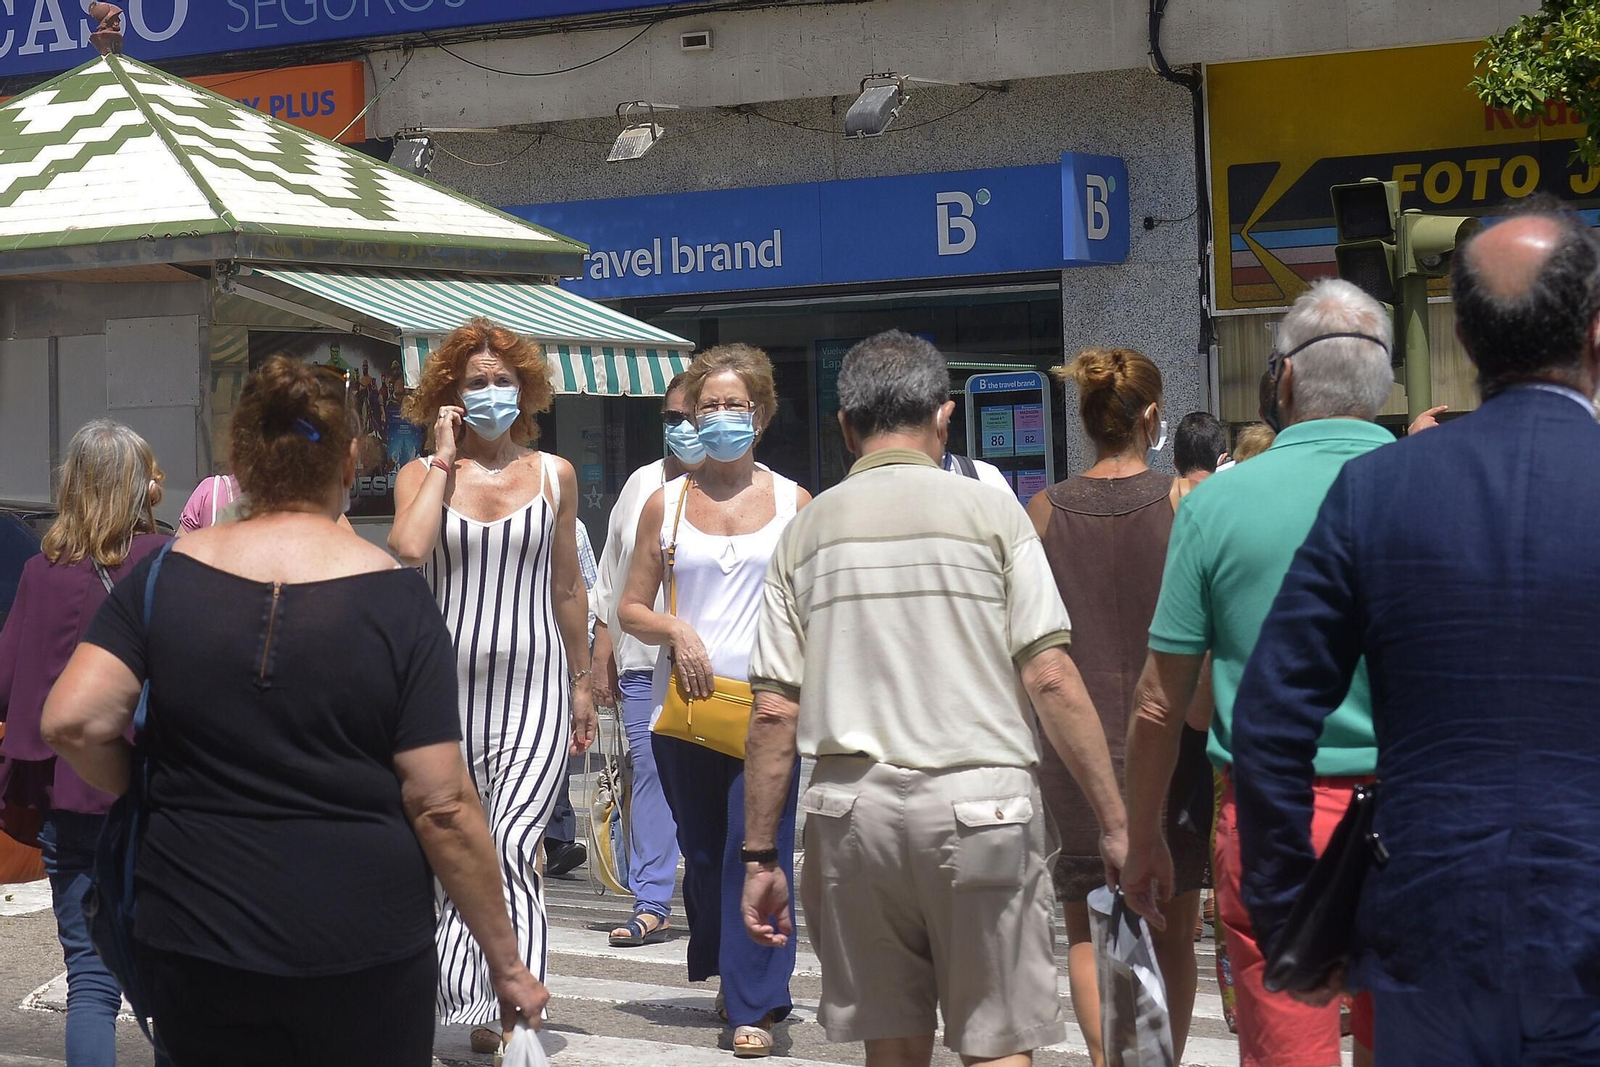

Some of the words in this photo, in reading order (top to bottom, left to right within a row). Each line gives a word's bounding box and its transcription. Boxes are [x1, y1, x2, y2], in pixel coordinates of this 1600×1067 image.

[270, 90, 335, 118] PLUS
[1391, 155, 1540, 204] FOTO
[565, 238, 662, 282] avel
[671, 229, 782, 274] brand
[1017, 379, 1036, 387] brand
[991, 435, 1005, 447] 80
